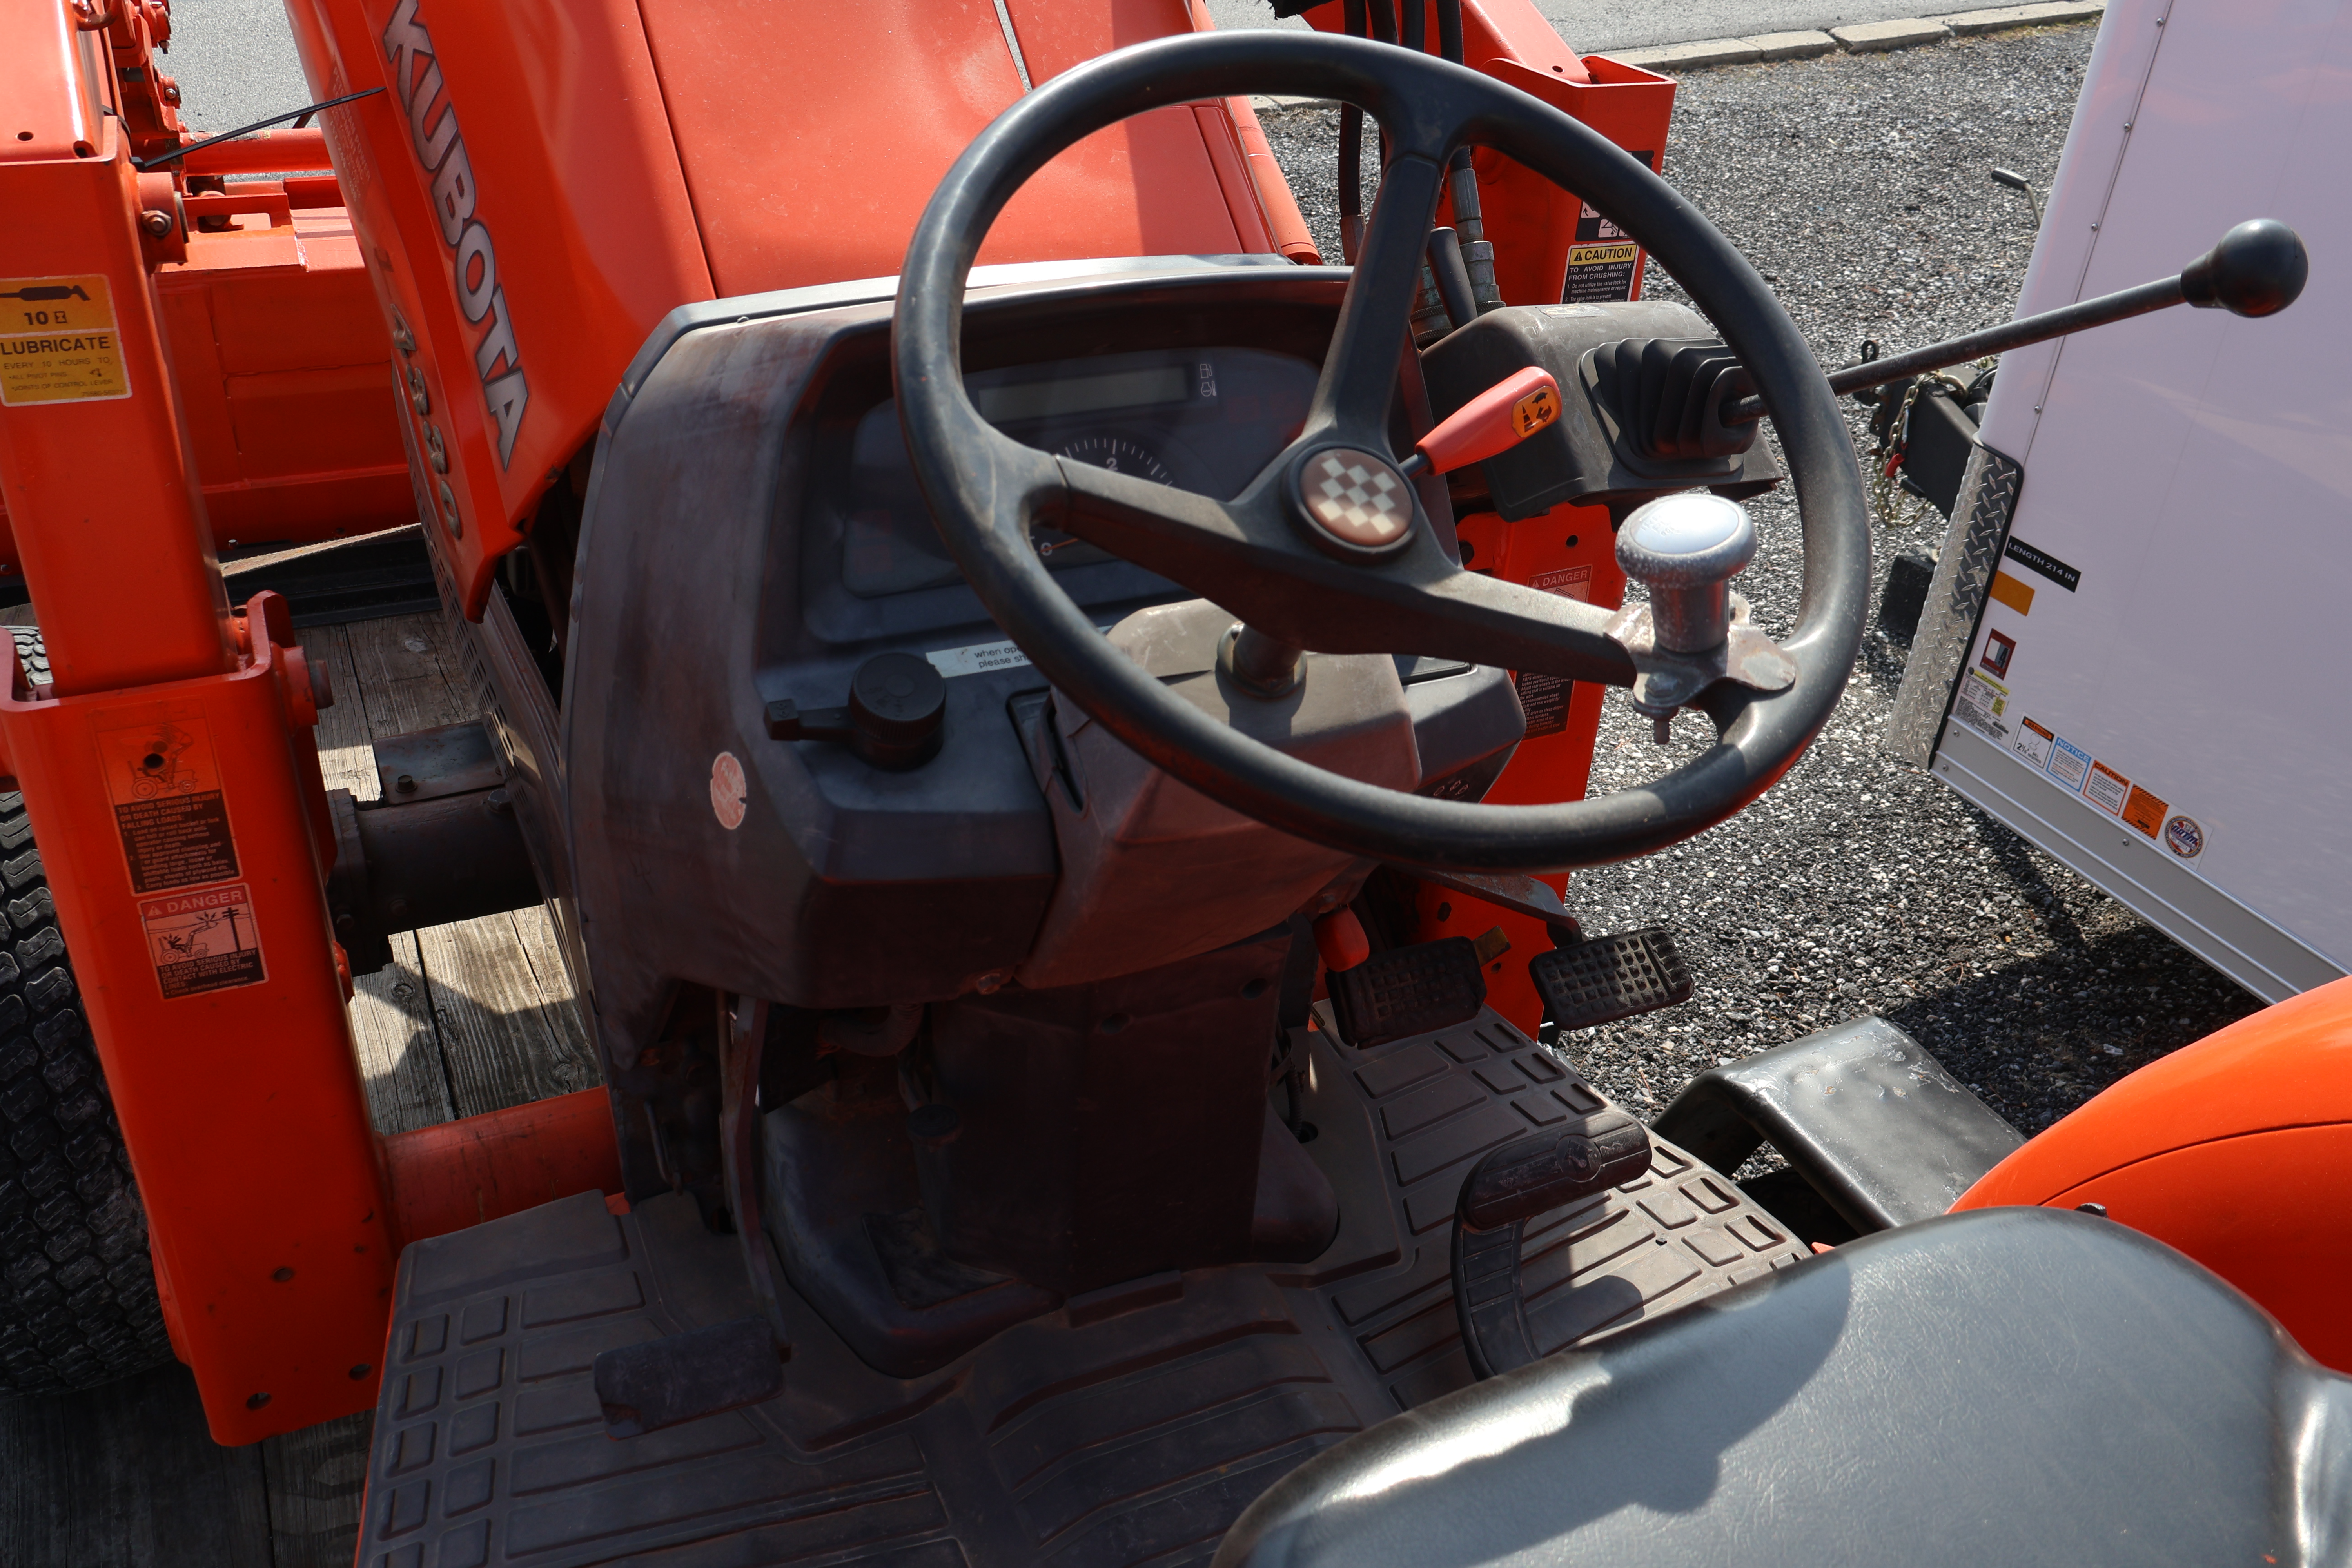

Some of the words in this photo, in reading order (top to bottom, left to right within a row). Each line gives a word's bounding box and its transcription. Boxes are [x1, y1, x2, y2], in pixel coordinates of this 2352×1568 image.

[383, 0, 530, 471] KUBOTA
[1584, 247, 1632, 260] CAUTION
[24, 311, 49, 325] 10
[0, 336, 111, 356] LUBRICATE
[4, 361, 34, 370] EVERY
[58, 357, 90, 366] HOURS
[1106, 457, 1118, 471] 2
[1040, 543, 1053, 555] 0
[2008, 542, 2044, 566] LENGTH
[2045, 562, 2063, 576] 214
[2064, 572, 2076, 582] IN
[1543, 570, 1588, 587] DANGER
[974, 648, 1002, 658] when
[978, 657, 1011, 669] please
[2028, 722, 2049, 737] WARNING
[2058, 739, 2090, 762] NOTICE
[2095, 762, 2128, 786] CAUTION
[130, 802, 155, 811] AVOID
[156, 797, 190, 807] SERIOUS
[133, 810, 159, 819] DEATH
[160, 805, 191, 815] CAUSED
[122, 819, 154, 829] FALLING
[156, 814, 185, 824] LOADS:
[165, 890, 243, 912] DANGER
[171, 961, 194, 970] AVOID
[196, 955, 228, 965] SERIOUS
[229, 949, 256, 959] INJURY
[162, 973, 196, 984] CONTACT
[198, 969, 217, 977] WITH
[218, 962, 254, 973] ELECTRIC
[174, 966, 198, 975] DEATH
[200, 961, 229, 970] CAUSED
